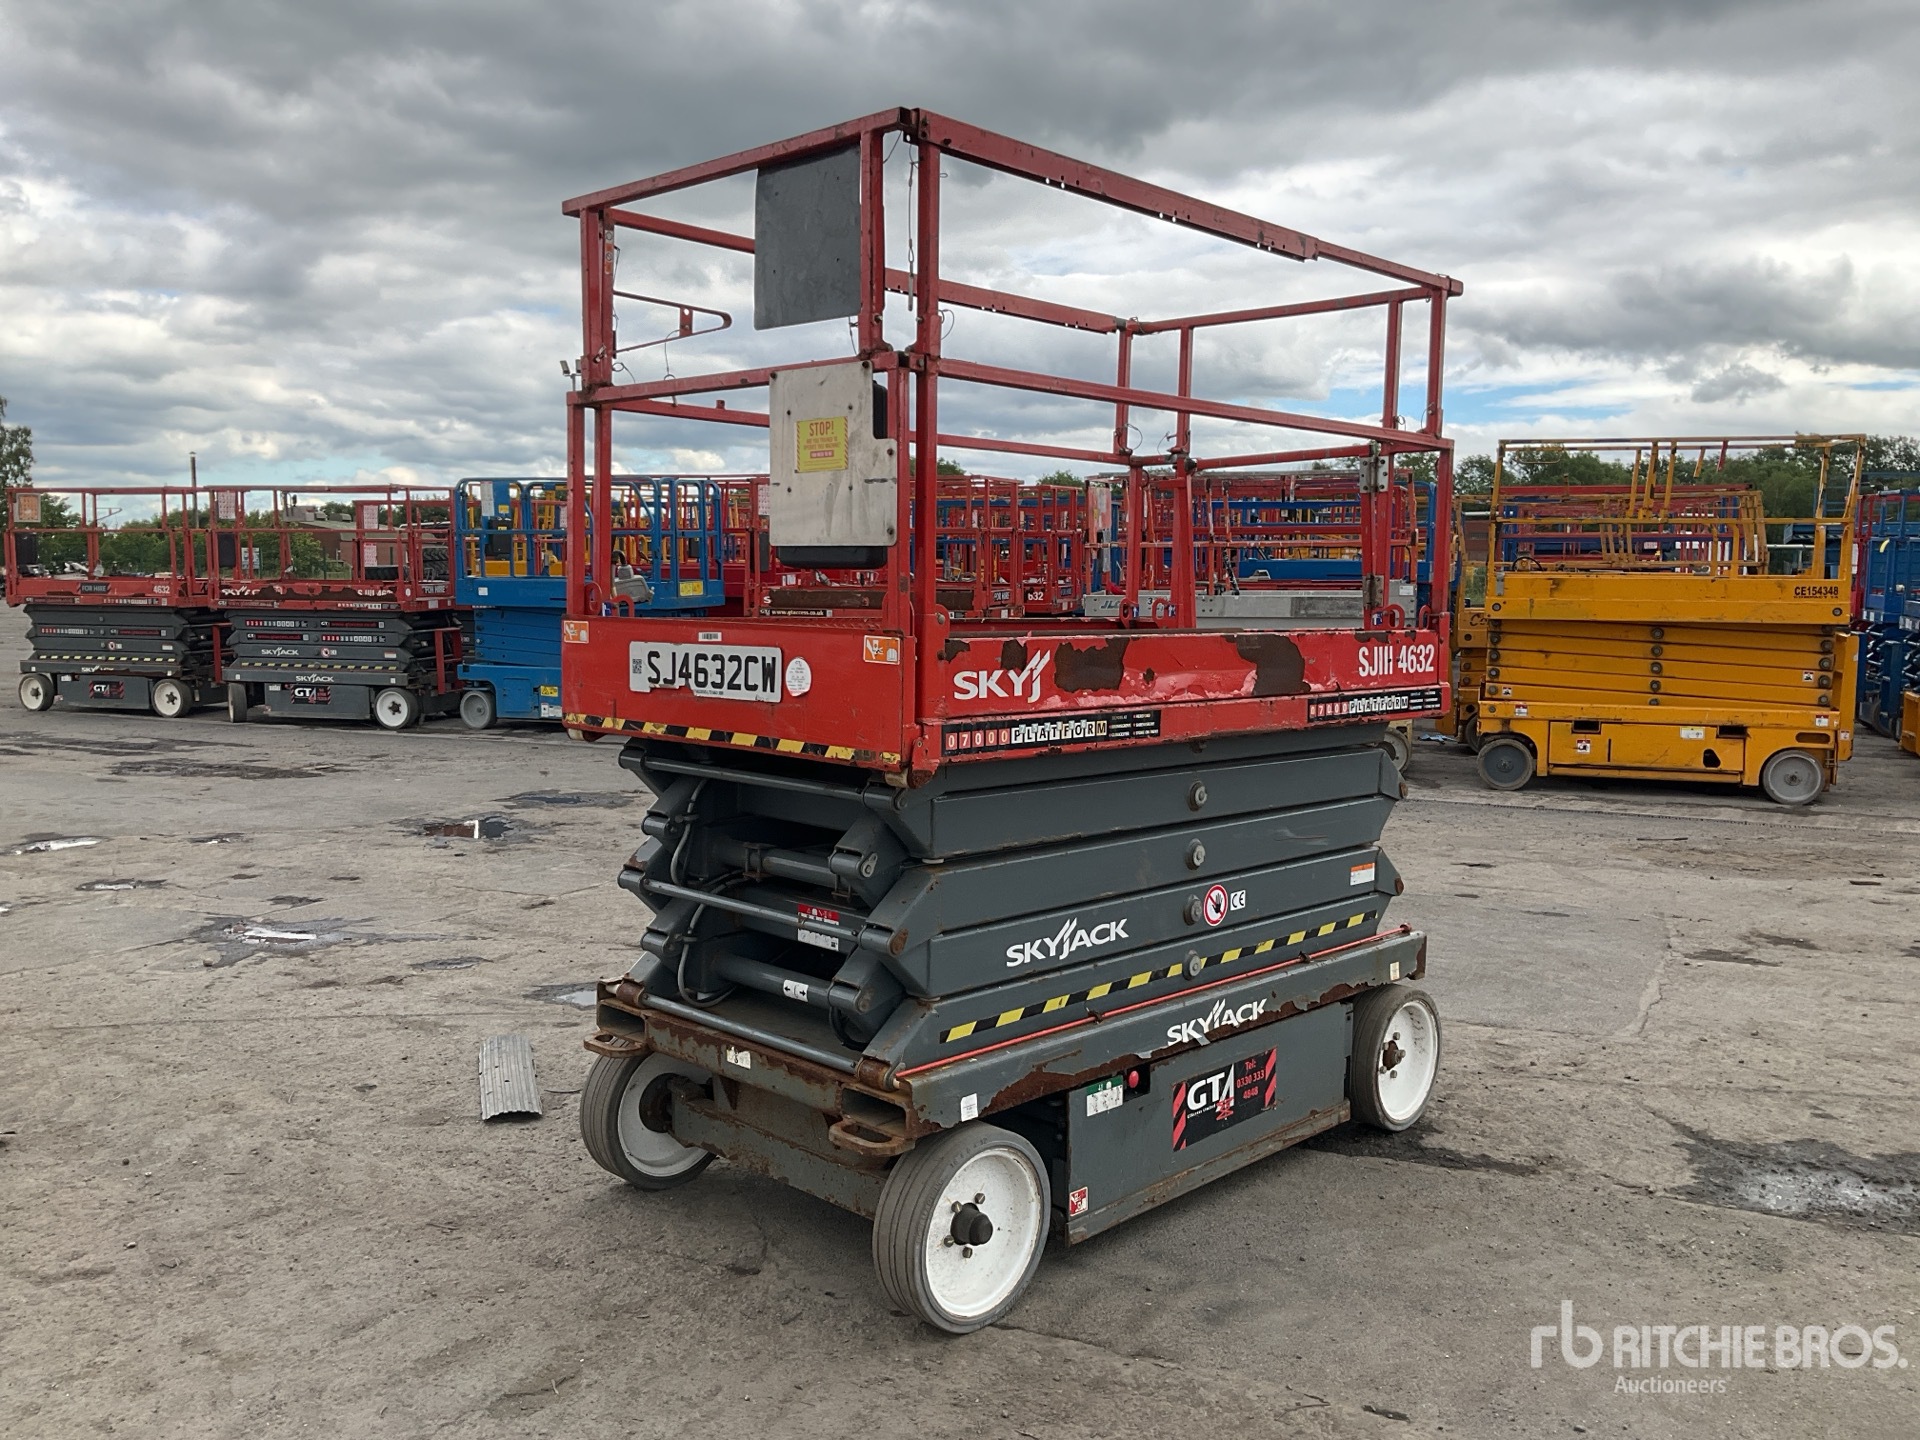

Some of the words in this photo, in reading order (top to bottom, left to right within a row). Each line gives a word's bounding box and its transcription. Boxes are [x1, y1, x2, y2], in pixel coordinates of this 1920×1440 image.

[810, 421, 834, 436] STOP!
[82, 583, 92, 591] FOR
[94, 583, 106, 591] HIRE
[153, 585, 170, 594] 4632
[1794, 586, 1838, 596] CE154348
[261, 647, 299, 656] SKYJACK
[1398, 644, 1435, 673] 4632
[648, 650, 776, 693] SJ4632CW
[296, 674, 334, 683] SKYJACK
[1006, 917, 1129, 967] SKYJACK
[1167, 998, 1267, 1046] SKYJACK
[1253, 1070, 1264, 1082] 333
